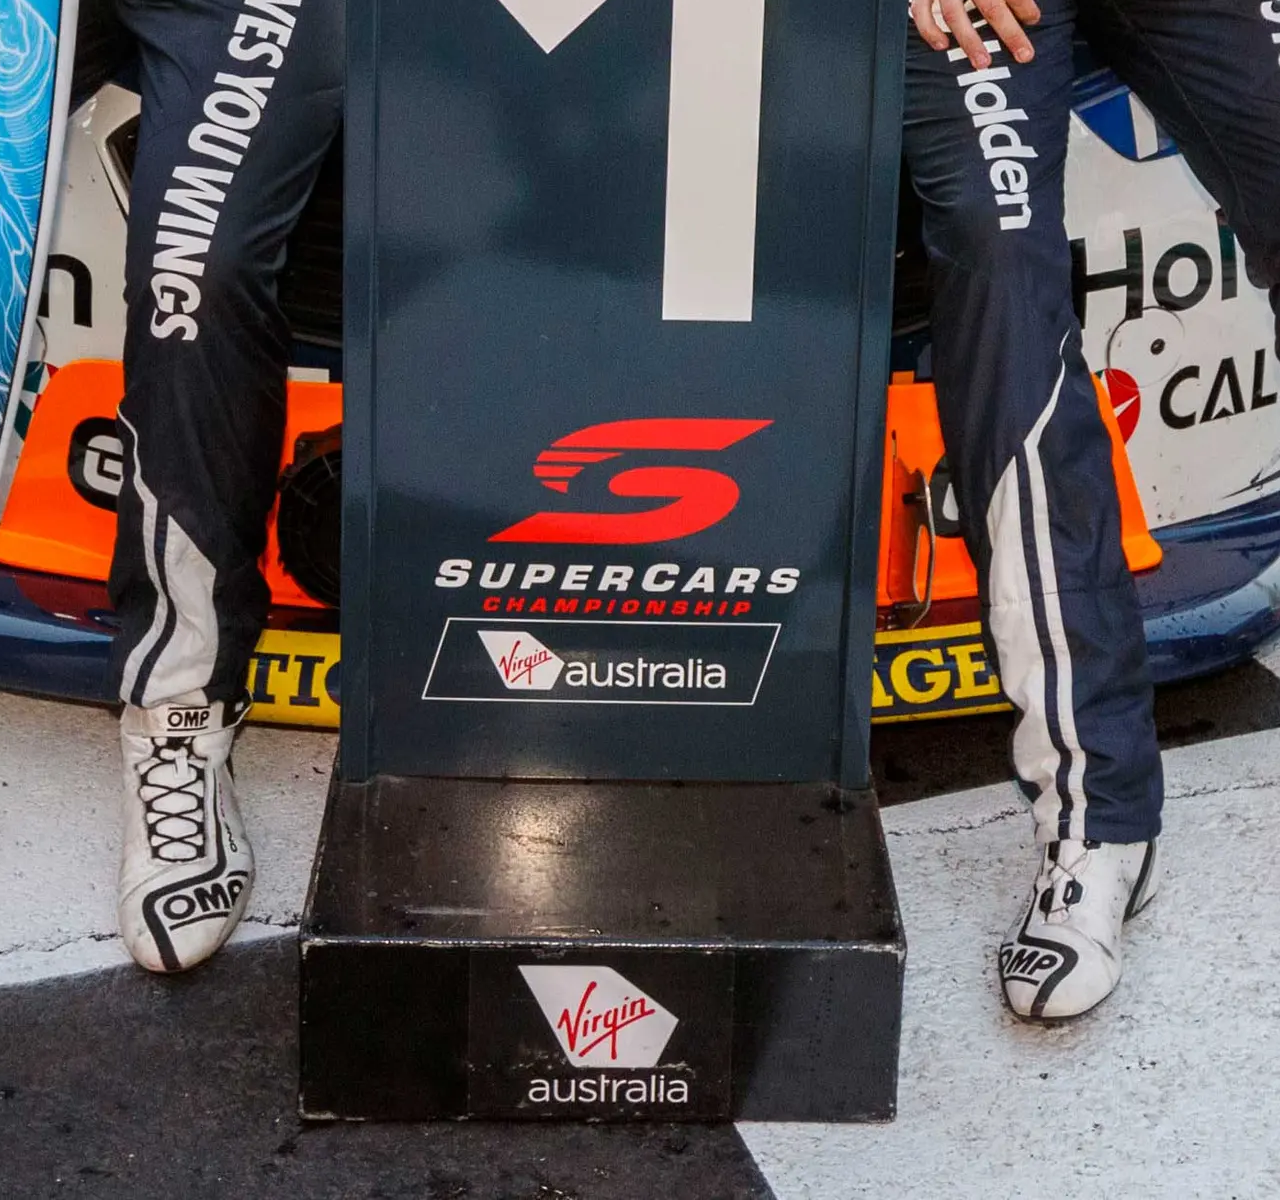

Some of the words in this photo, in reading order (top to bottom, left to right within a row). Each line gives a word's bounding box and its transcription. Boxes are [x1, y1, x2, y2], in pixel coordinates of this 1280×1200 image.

[187, 71, 276, 167] YOU
[150, 165, 235, 341] WINGS
[434, 558, 801, 595] SUPERCARS
[482, 595, 754, 617] CHAMPIONSHIP
[499, 640, 553, 685] Virgin
[565, 656, 727, 689] australia
[167, 710, 211, 728] OMP
[162, 878, 244, 920] OMP
[557, 980, 656, 1061] Virgin
[528, 1073, 690, 1104] australia
